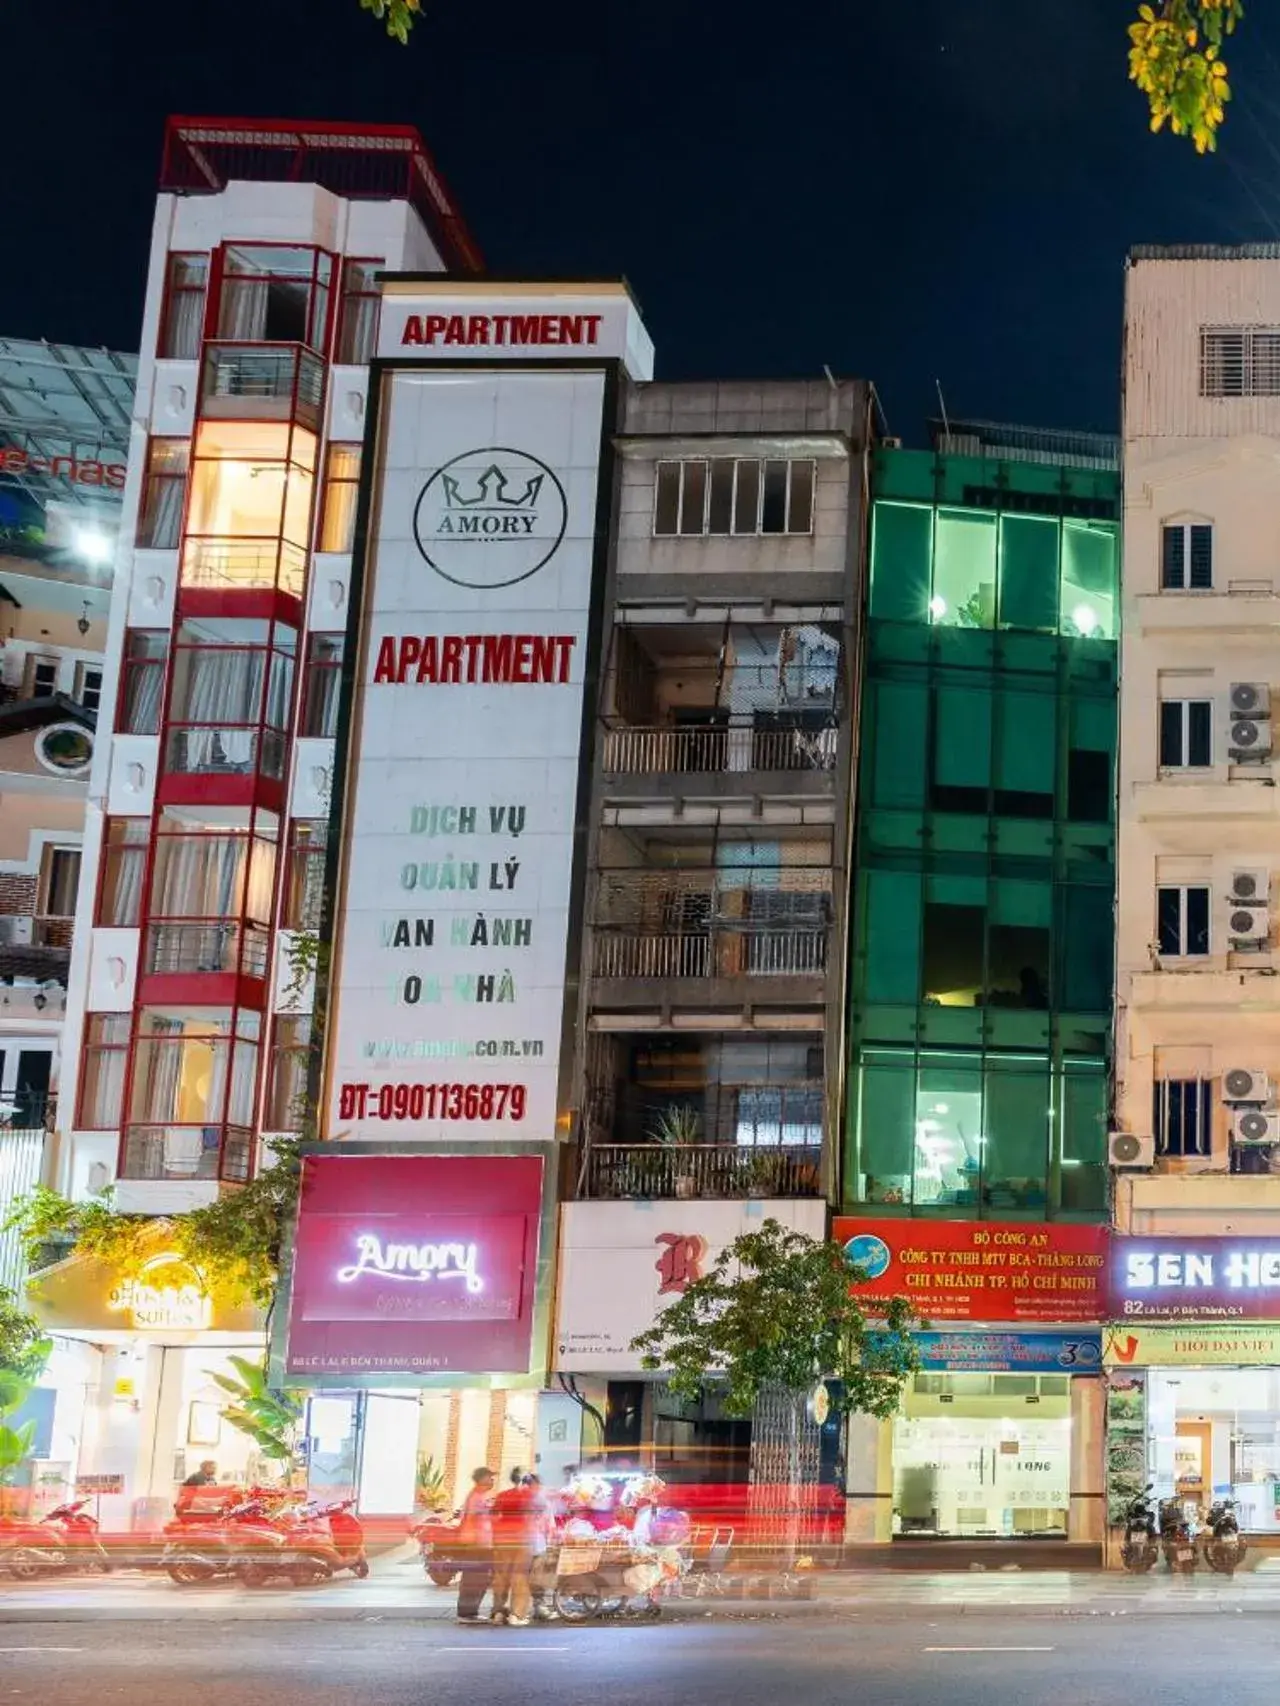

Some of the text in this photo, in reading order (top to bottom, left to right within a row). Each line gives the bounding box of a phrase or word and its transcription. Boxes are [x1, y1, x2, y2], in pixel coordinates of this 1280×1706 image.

[402, 315, 603, 346] APARTMENT
[436, 516, 538, 534] AMORY
[374, 634, 577, 684] APARTMENT
[410, 805, 526, 838] DỊCH VỤ
[489, 855, 520, 890] LÝ
[450, 912, 532, 946] HÀNH
[993, 1232, 1026, 1246] CÔNG
[1029, 1233, 1049, 1246] AN
[337, 1234, 485, 1294] Amory
[900, 1248, 929, 1264] CÔNG
[930, 1251, 946, 1265] TY
[948, 1252, 980, 1266] TNHH
[982, 1252, 1006, 1266] MTV
[1076, 1254, 1105, 1267] LONG
[1126, 1252, 1214, 1288] SEN
[906, 1273, 930, 1287] CHI
[933, 1271, 985, 1288] NHÁNH
[1060, 1276, 1097, 1289] MINH
[1123, 1299, 1144, 1315] 82
